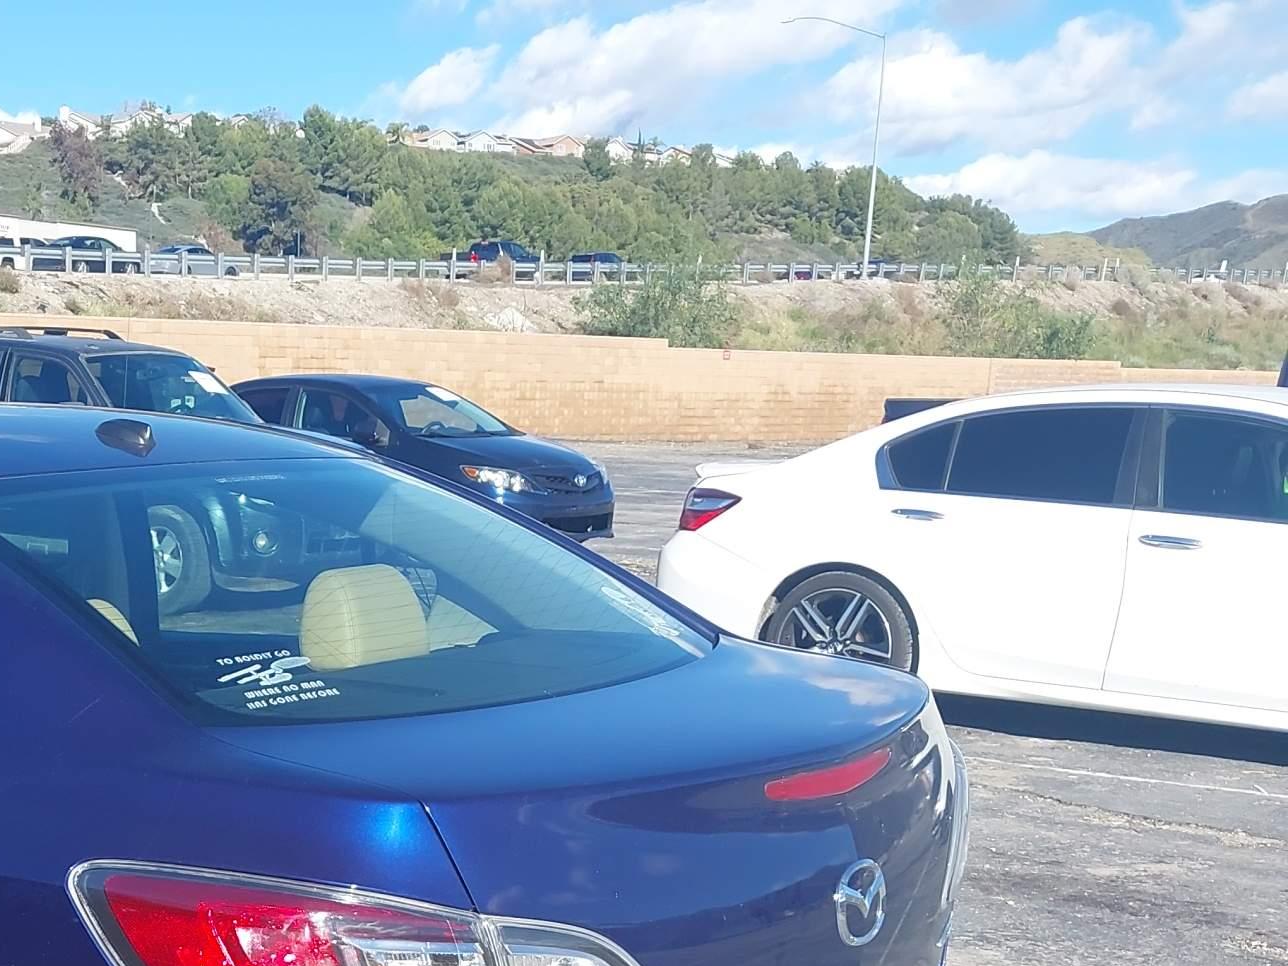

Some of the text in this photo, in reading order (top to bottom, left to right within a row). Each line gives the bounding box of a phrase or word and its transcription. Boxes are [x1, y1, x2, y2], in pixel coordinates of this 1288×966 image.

[215, 657, 233, 666] TO
[274, 649, 291, 657] GO
[244, 680, 325, 699] WHERE NO MAN
[245, 687, 341, 710] HAS GONE BEFORE
